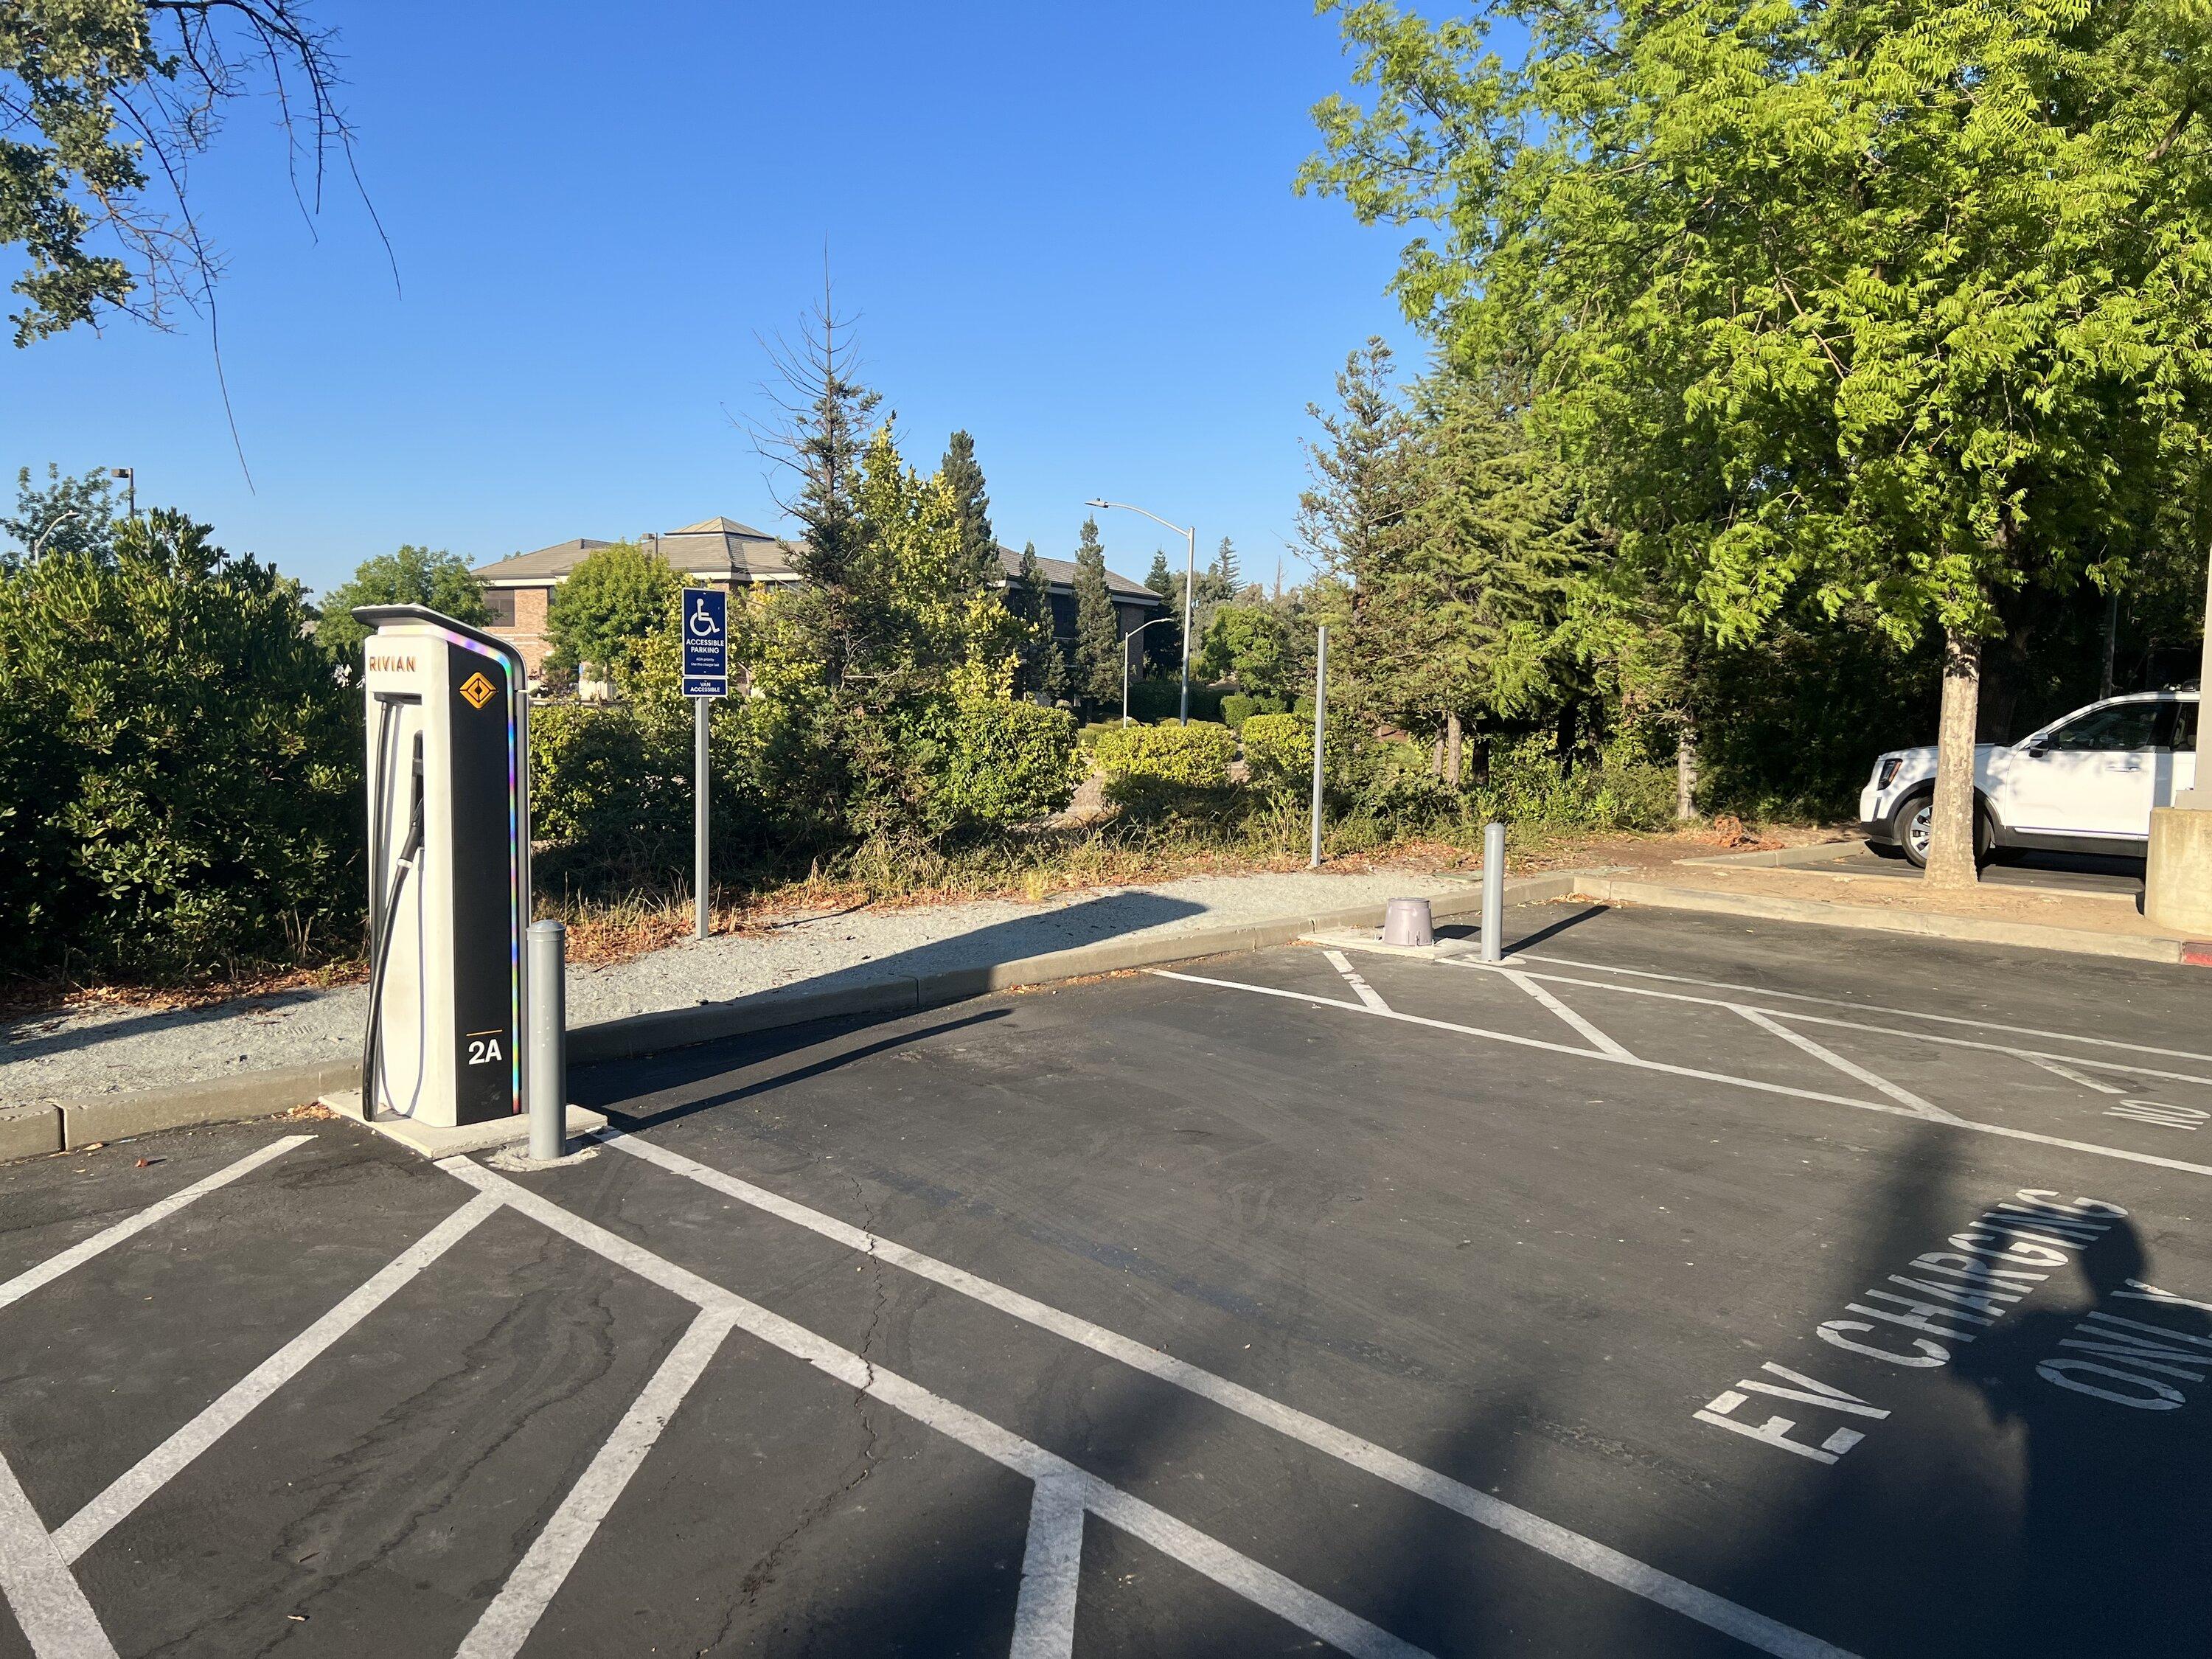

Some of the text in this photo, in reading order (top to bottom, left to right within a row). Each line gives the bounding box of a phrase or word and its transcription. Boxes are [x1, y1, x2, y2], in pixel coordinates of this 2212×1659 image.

[686, 639, 725, 647] ACCESSIBLE
[369, 656, 416, 672] RIVIAN
[468, 1038, 502, 1065] 2A
[2101, 1099, 2211, 1131] NO
[1691, 1188, 2129, 1466] EV CHARGING
